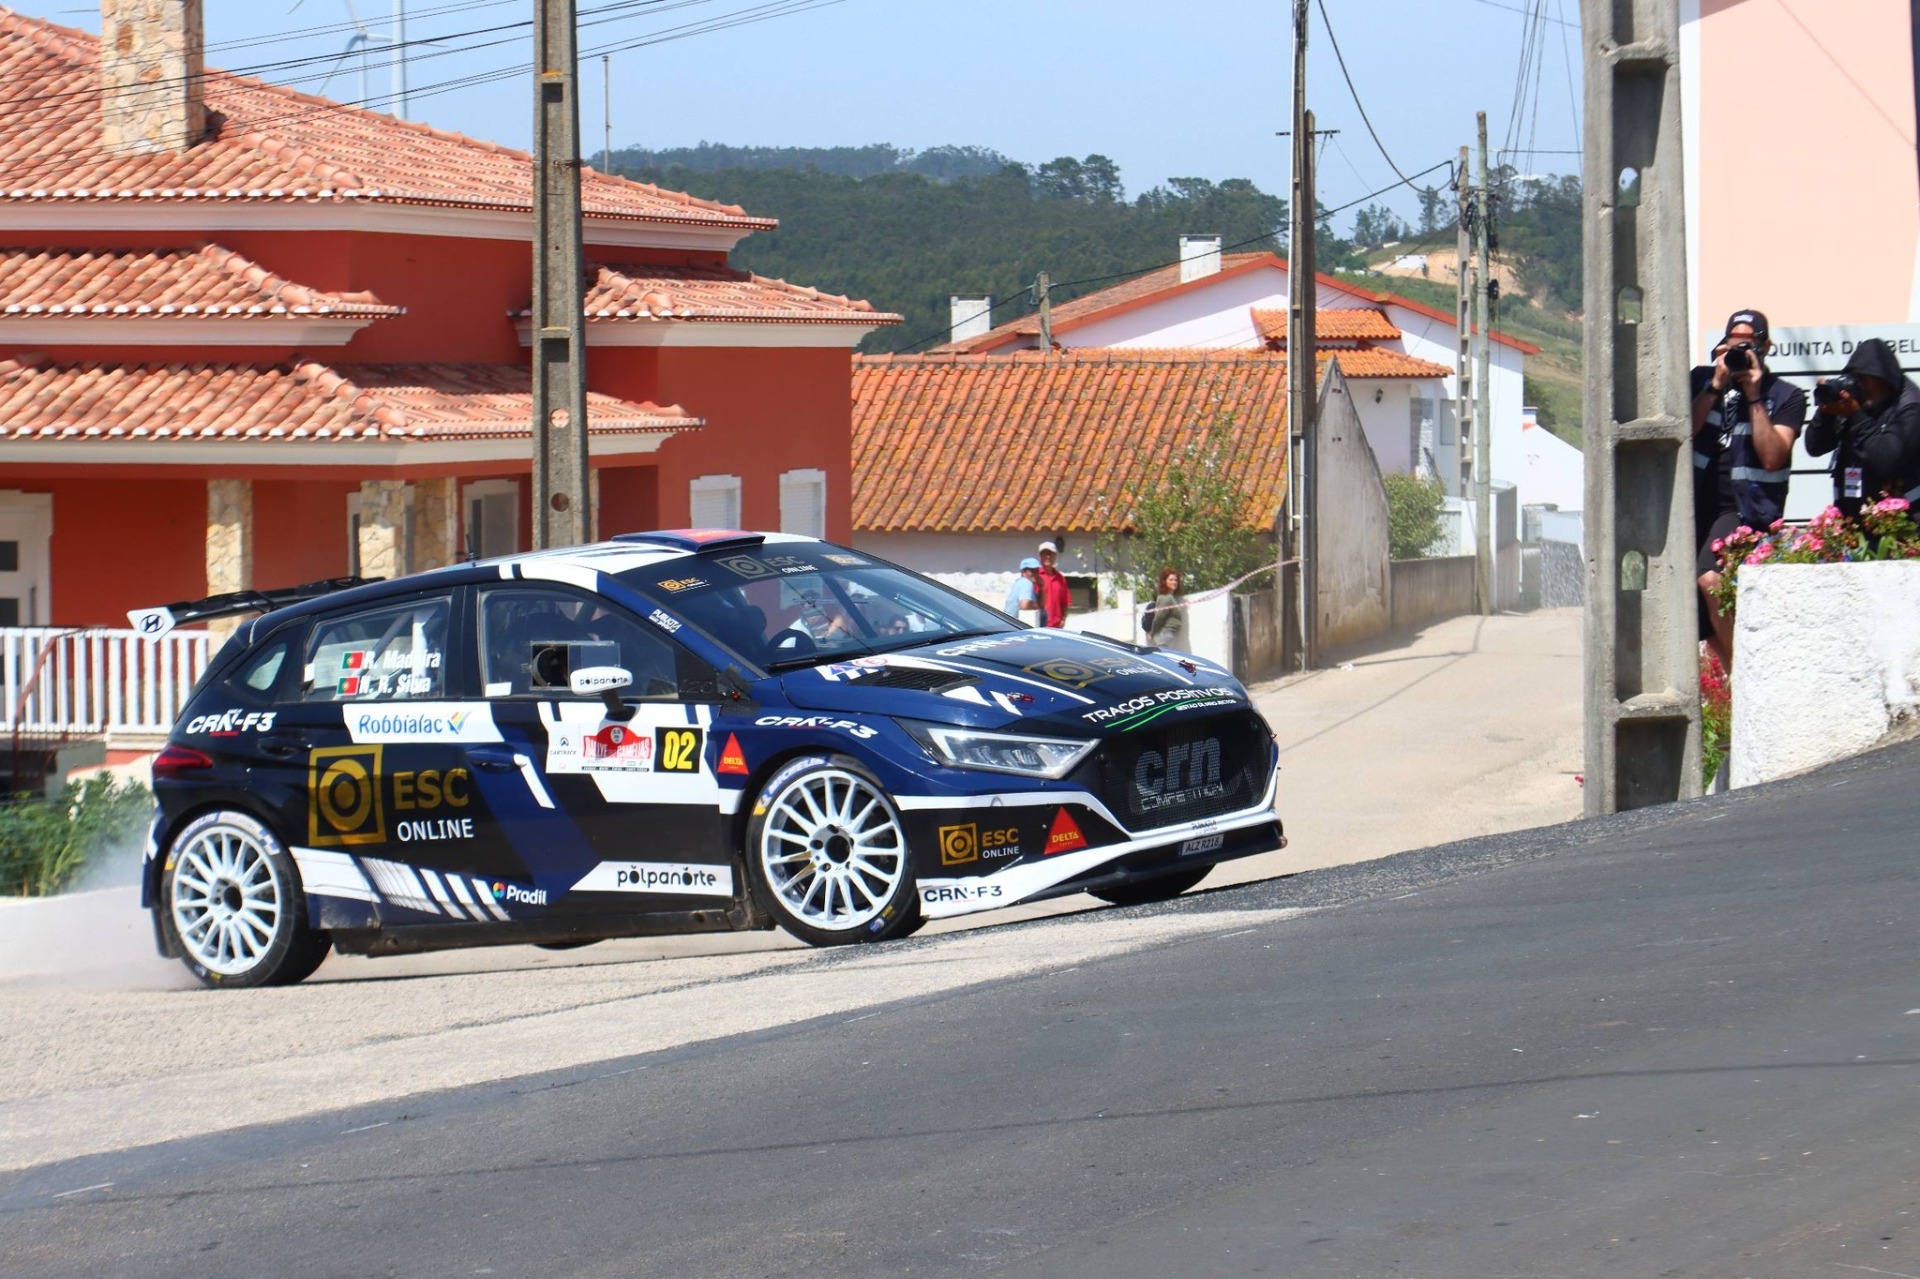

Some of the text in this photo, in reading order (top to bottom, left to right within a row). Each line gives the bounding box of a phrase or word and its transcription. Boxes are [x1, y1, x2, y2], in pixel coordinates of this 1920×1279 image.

[762, 556, 805, 567] ESC
[782, 565, 818, 574] ONLINE
[383, 649, 441, 669] Madira
[378, 675, 392, 693] R.
[396, 673, 431, 694] Silva
[1082, 687, 1234, 722] TRAÇOS POSITIVOS
[359, 714, 443, 734] Robbialac
[663, 731, 696, 769] 02
[723, 757, 743, 766] DELTA
[1135, 737, 1221, 797] crn
[393, 768, 469, 810] ESC
[397, 818, 474, 841] ONLINE
[982, 828, 1019, 847] ESC
[1052, 832, 1079, 843] DELTA
[982, 846, 1020, 859] ONLINE
[617, 866, 717, 887] polpanorte
[923, 885, 1003, 903] CRN-F3
